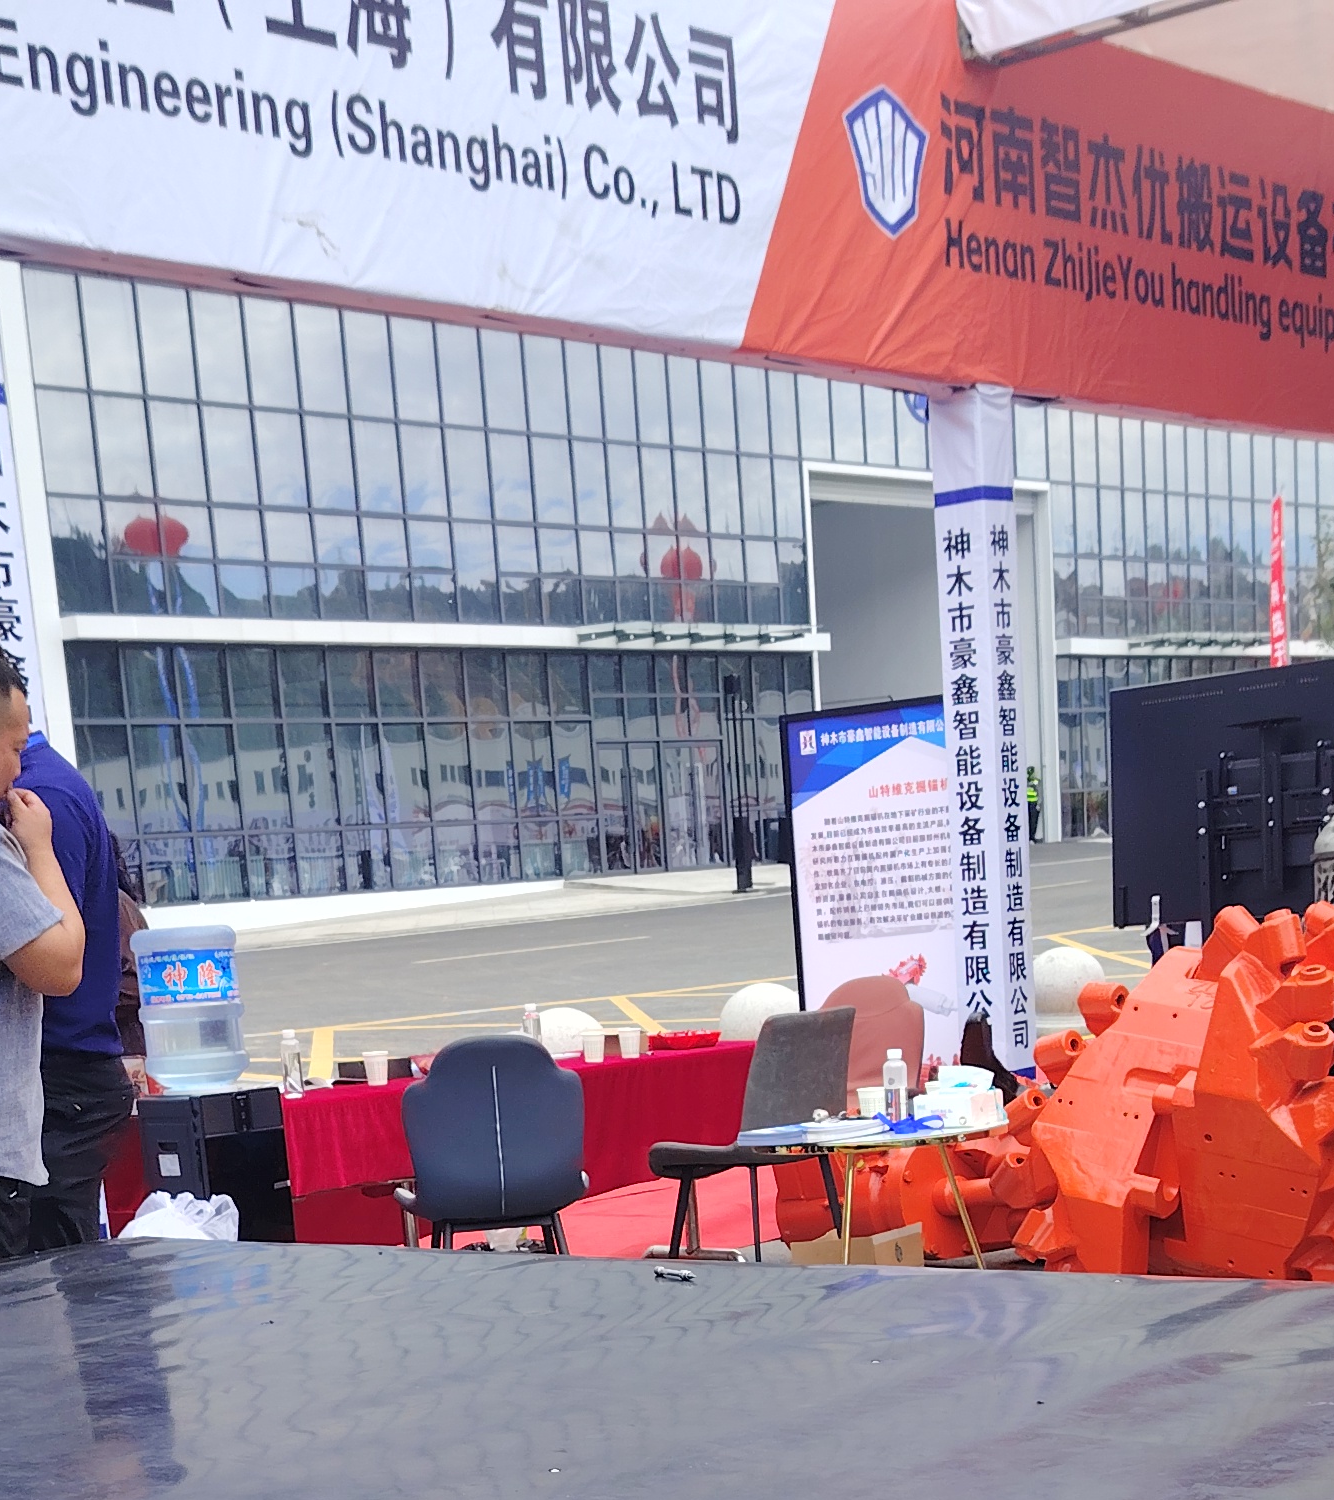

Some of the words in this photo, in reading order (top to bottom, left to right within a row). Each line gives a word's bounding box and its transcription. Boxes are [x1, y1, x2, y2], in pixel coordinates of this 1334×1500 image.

[331, 90, 568, 200] (Shanghai)
[583, 143, 658, 219] Co.,
[671, 160, 741, 226] LTD
[944, 217, 1036, 284] Henan
[1171, 261, 1271, 341] handling
[989, 522, 1031, 1051] 神木市豪鑫智能设备制造有限公司
